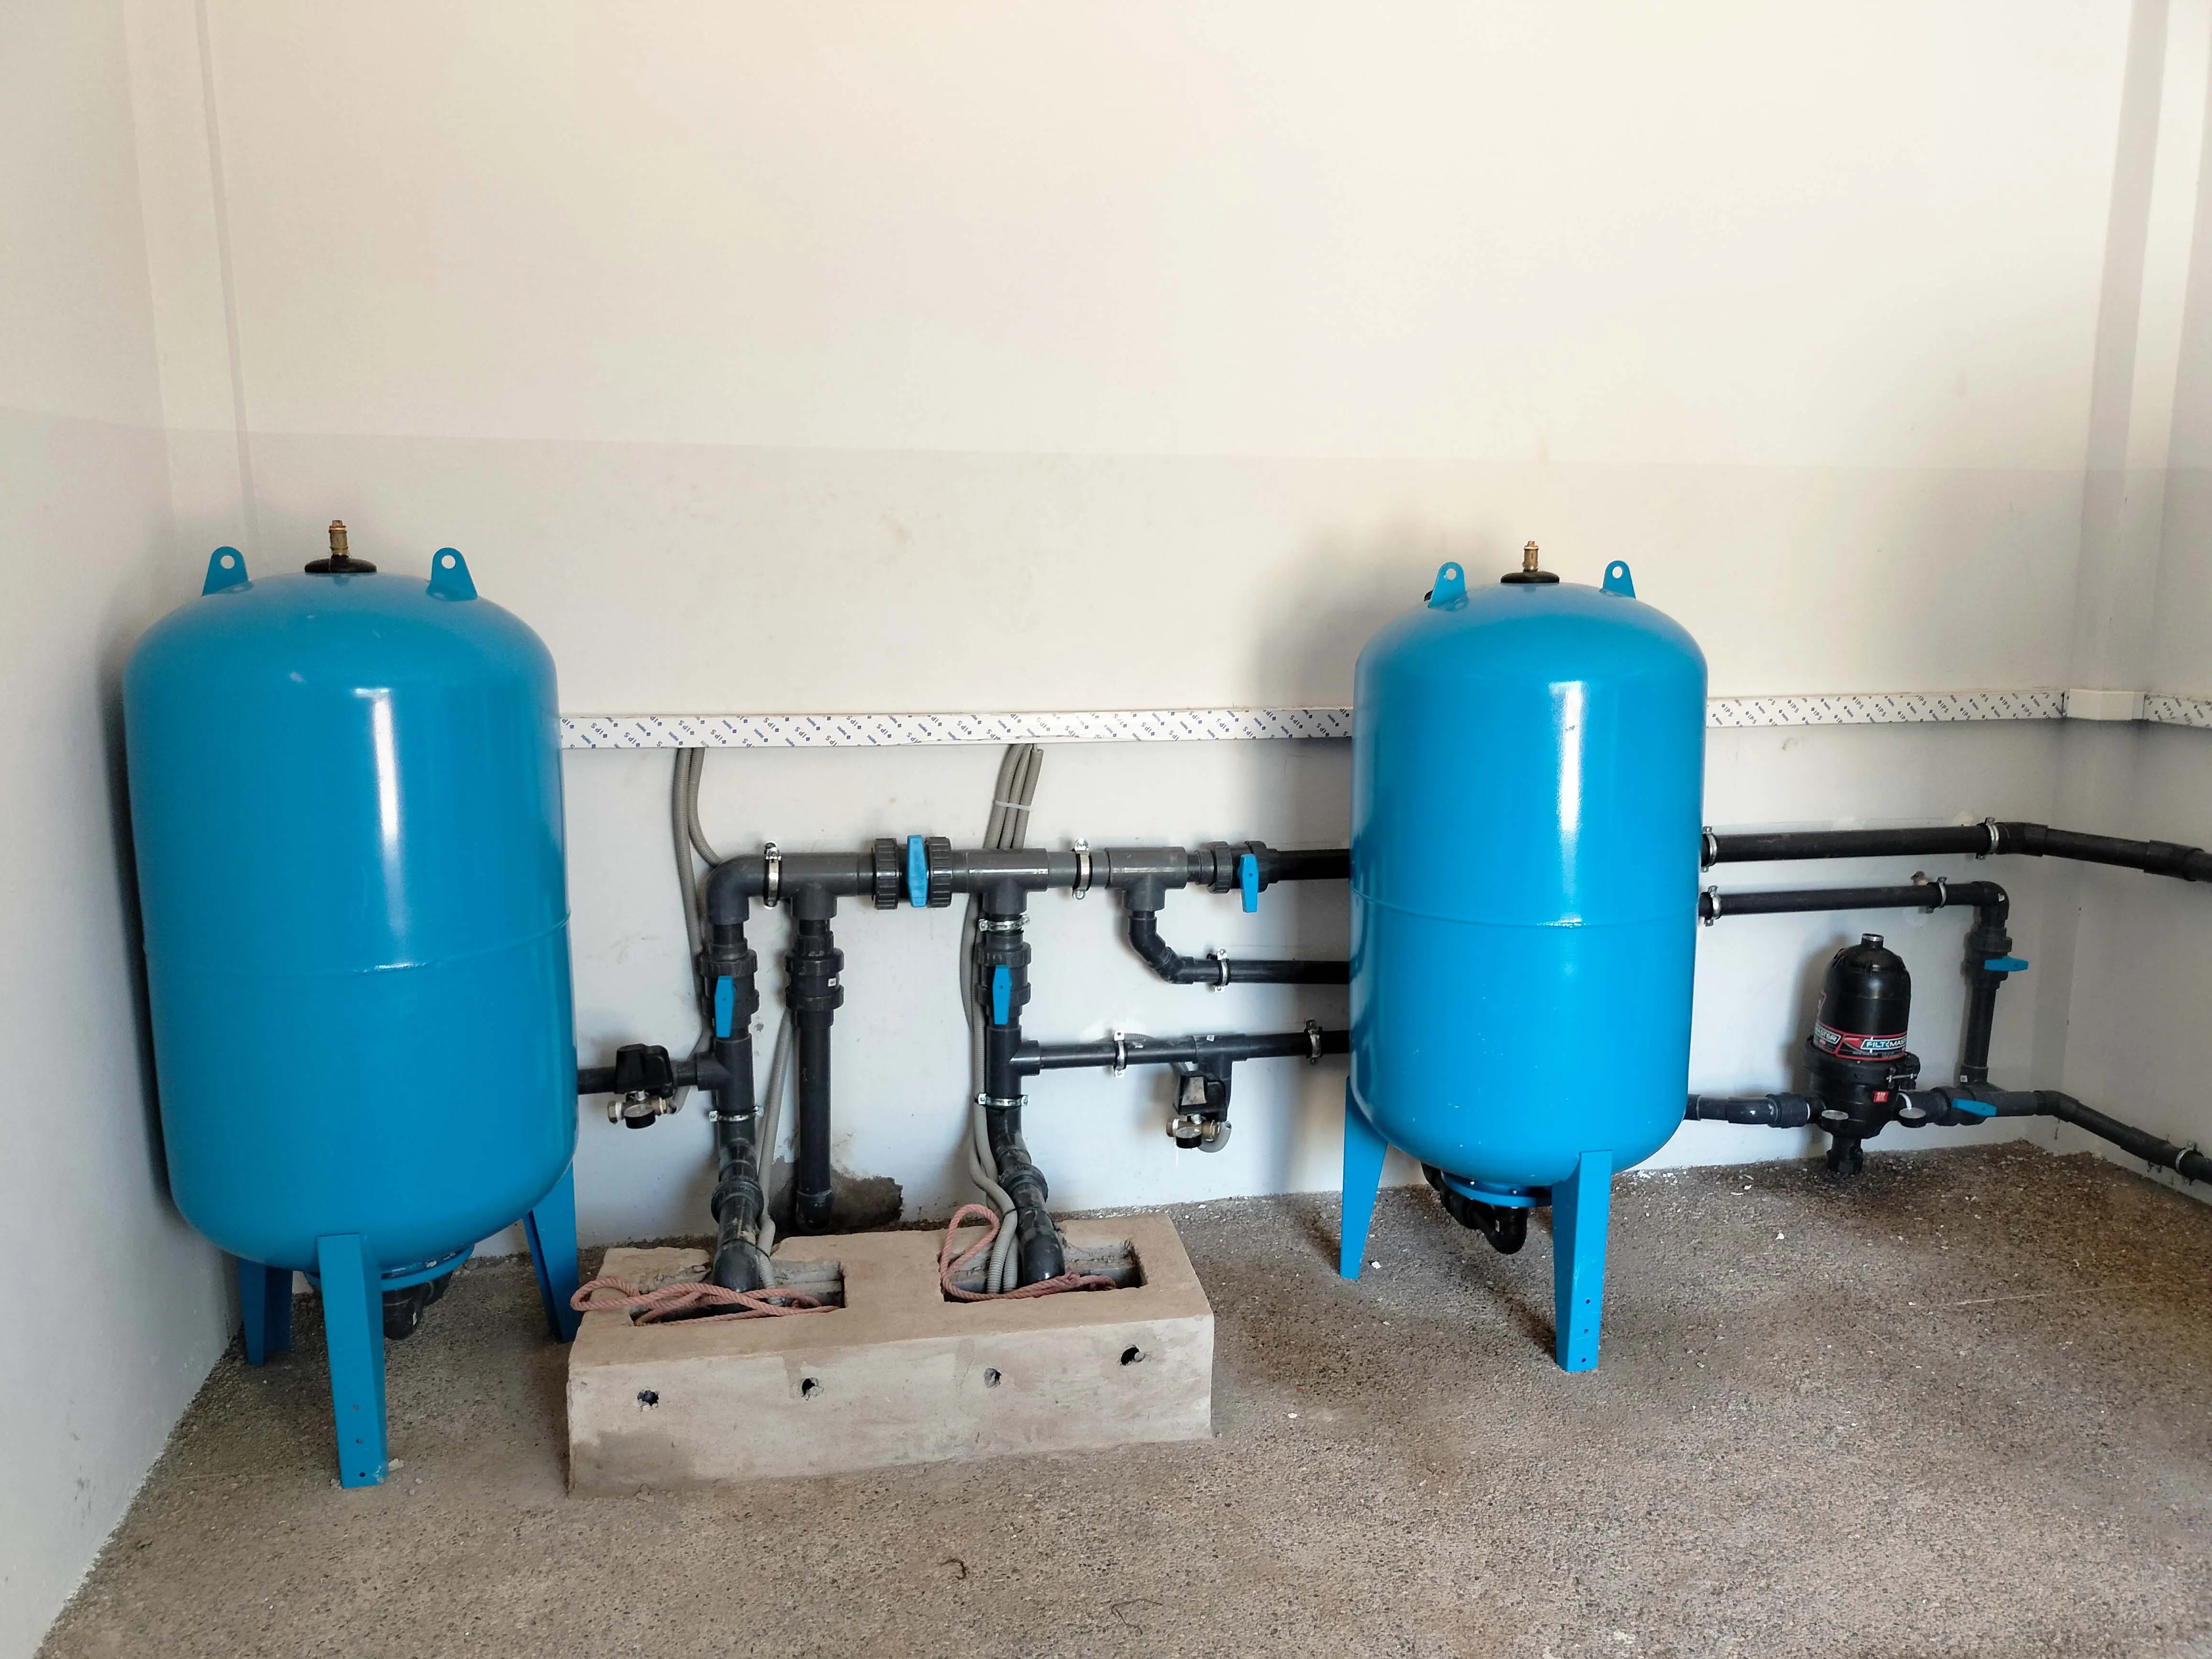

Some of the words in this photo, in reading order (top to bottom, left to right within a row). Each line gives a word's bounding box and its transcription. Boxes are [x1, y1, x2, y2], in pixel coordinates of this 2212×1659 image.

[1790, 702, 1799, 713] IPS
[1855, 698, 1864, 709] IPS
[1940, 703, 1949, 713] IPS
[2002, 699, 2011, 709] IPS
[1724, 706, 1733, 717] IPS
[1813, 709, 1823, 720] IPS
[1877, 706, 1886, 717] IPS
[2024, 707, 2032, 717] IPS
[763, 717, 775, 729] IPS
[1289, 715, 1300, 726] IPS
[1747, 714, 1757, 725] IPS
[591, 723, 604, 735] IPS
[678, 720, 691, 732] IPS
[876, 724, 888, 735] IPS
[957, 720, 969, 732] IPS
[1064, 725, 1076, 736] IPS
[1141, 722, 1152, 733] IPS
[1243, 726, 1253, 737] IPS
[1316, 723, 1327, 733] IPS
[710, 729, 723, 741] IPS
[795, 726, 807, 738] IPS
[986, 729, 998, 740] IPS
[1168, 730, 1179, 741] IPS
[624, 732, 637, 744] IPS
[825, 735, 838, 747] IPS
